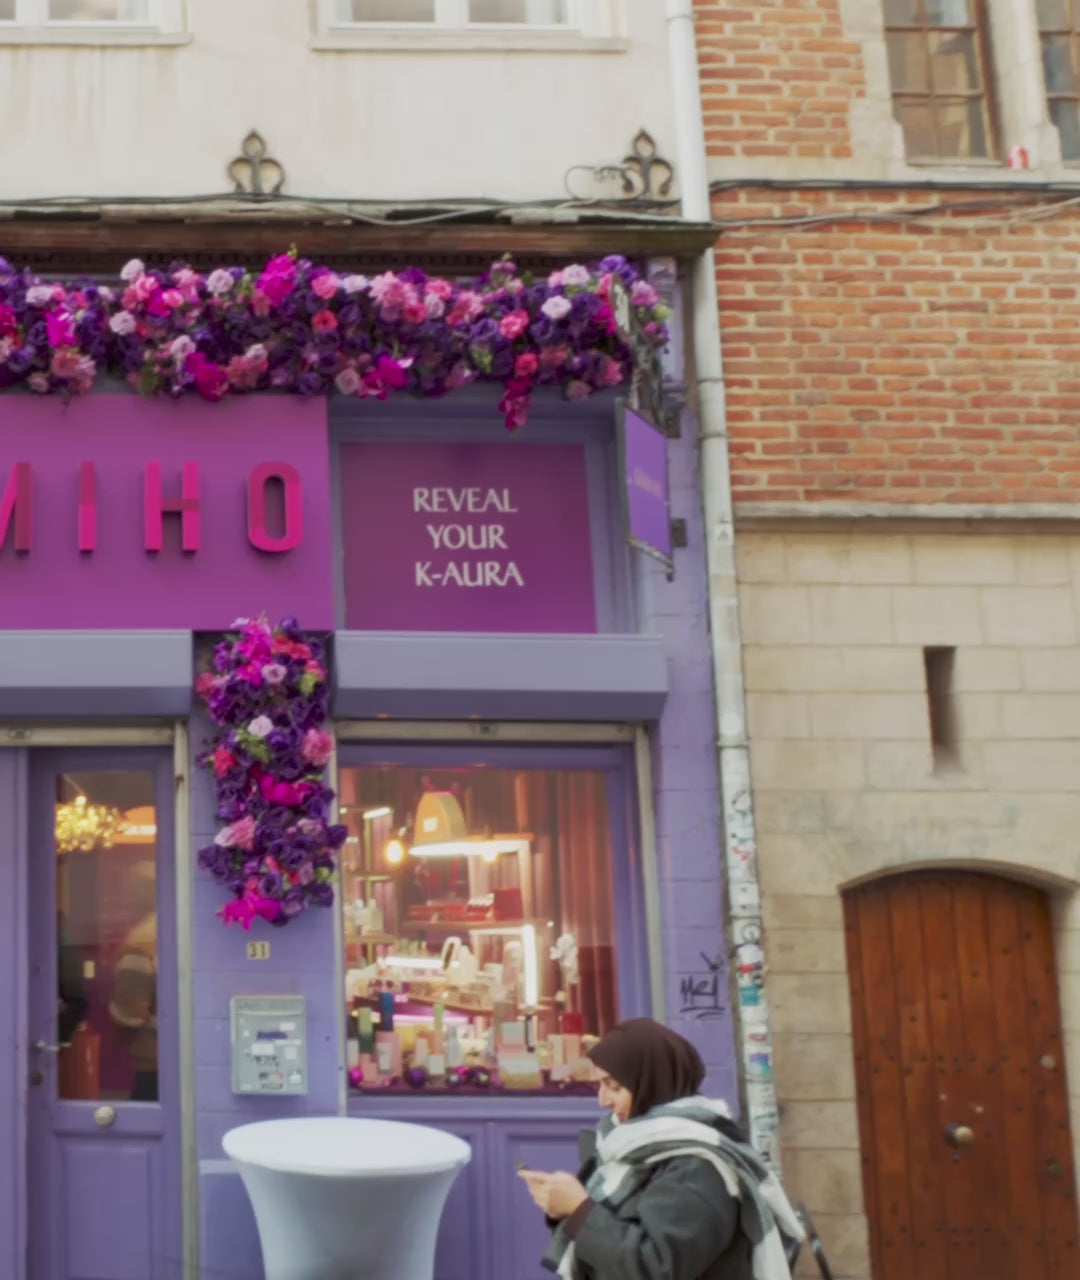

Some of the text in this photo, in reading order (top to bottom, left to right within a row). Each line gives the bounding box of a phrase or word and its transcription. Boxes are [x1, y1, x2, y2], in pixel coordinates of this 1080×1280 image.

[412, 487, 518, 513] REVEAL
[426, 524, 509, 550] YOUR
[414, 561, 525, 587] K-AURA
[248, 942, 266, 959] 31
